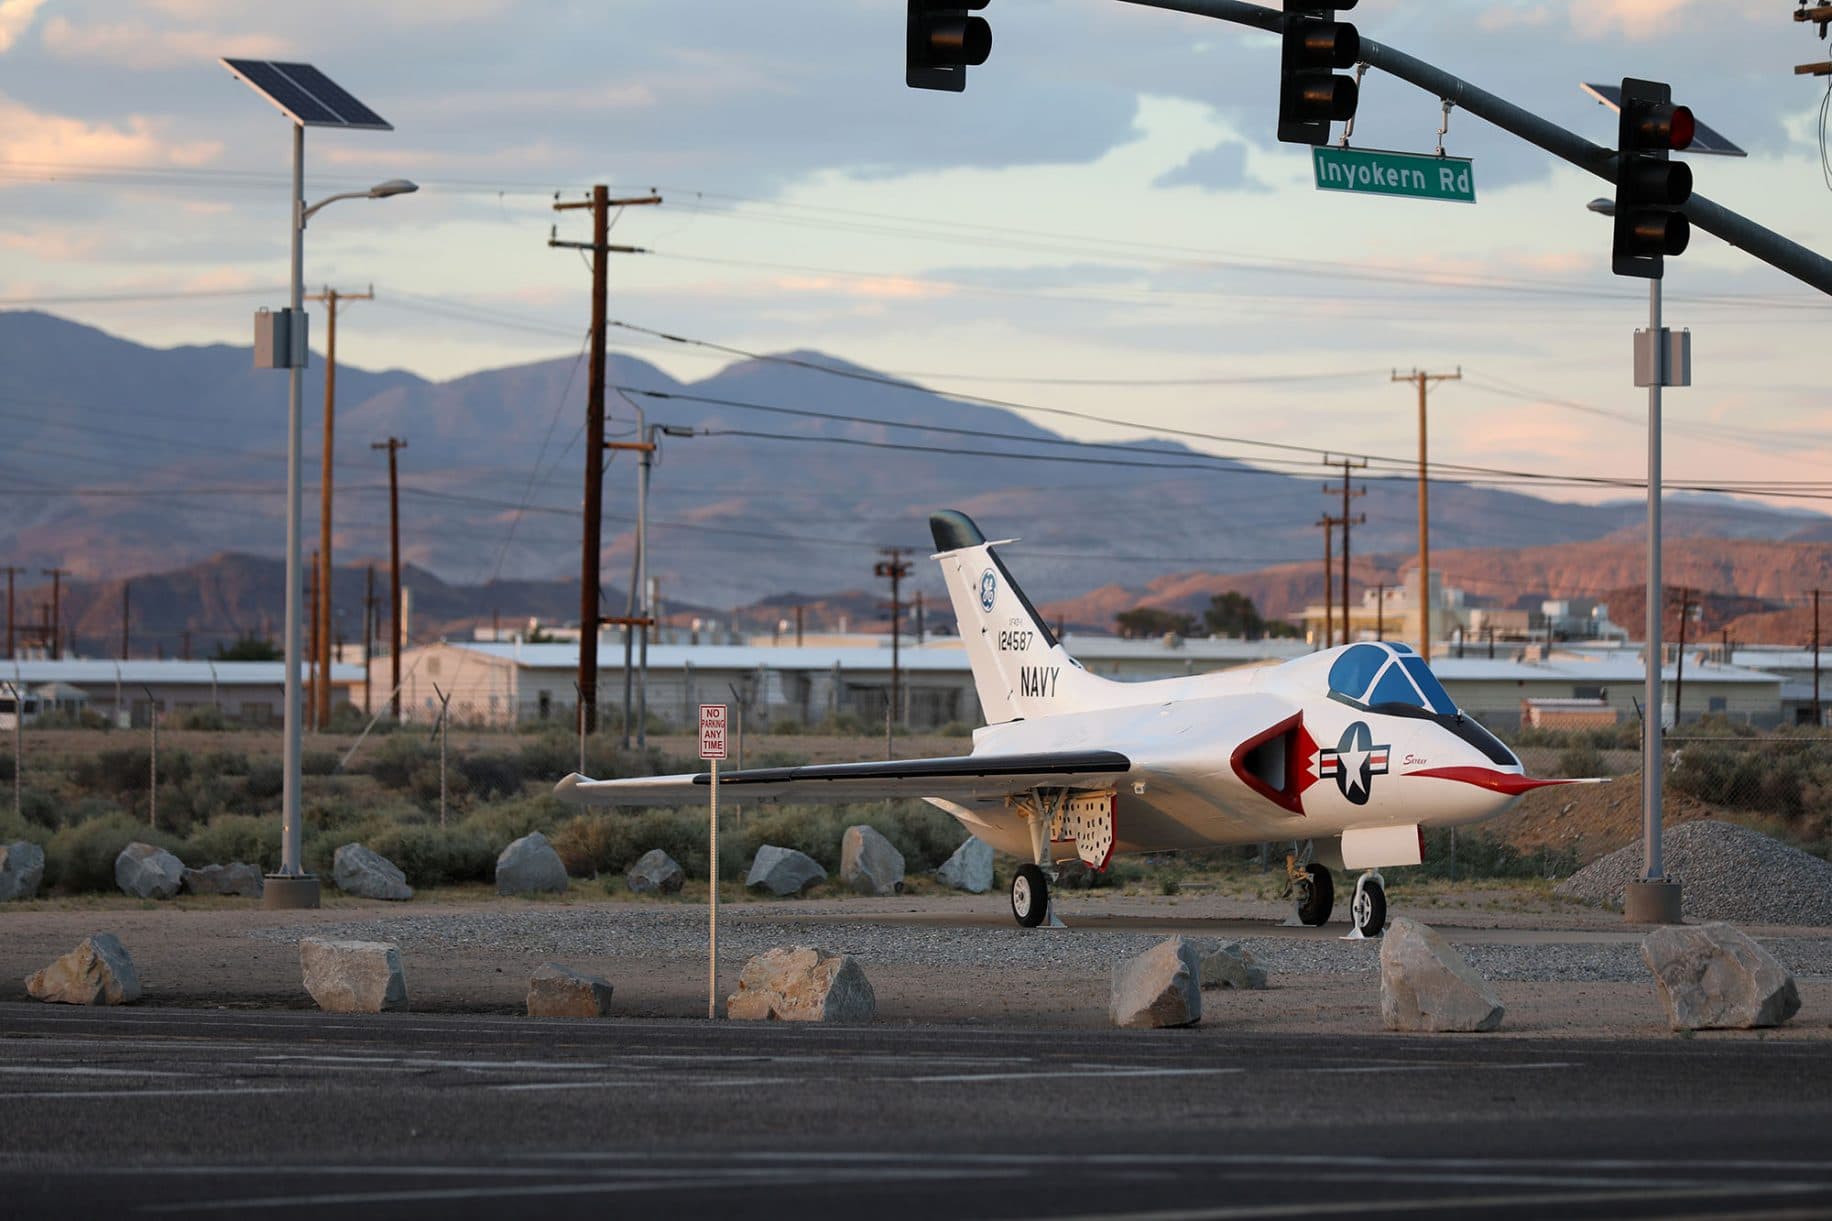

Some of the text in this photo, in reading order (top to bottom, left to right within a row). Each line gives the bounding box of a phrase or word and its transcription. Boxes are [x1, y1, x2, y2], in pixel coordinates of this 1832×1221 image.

[1319, 156, 1471, 193] Inyokern Rd
[998, 631, 1034, 651] 124587
[1021, 666, 1060, 697] NAVY
[706, 709, 720, 718] NO
[704, 730, 721, 738] ANY
[703, 740, 723, 749] TIME
